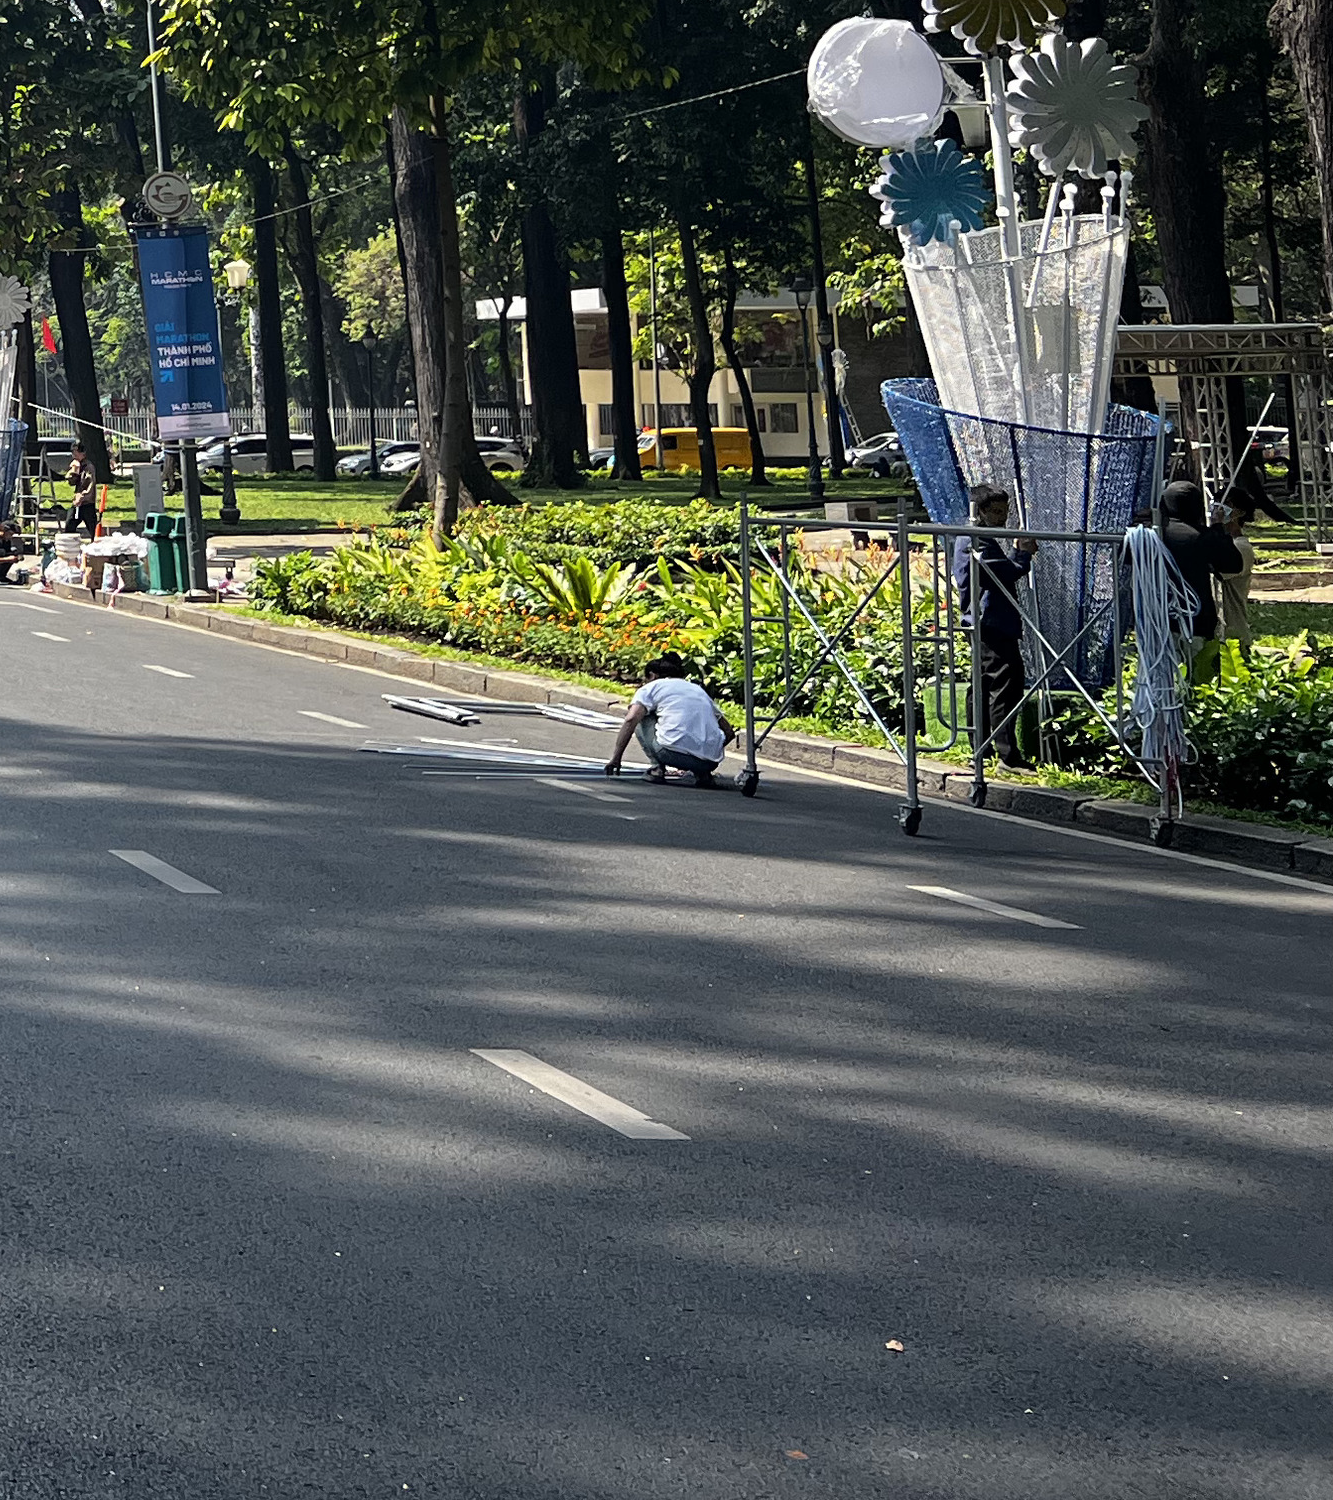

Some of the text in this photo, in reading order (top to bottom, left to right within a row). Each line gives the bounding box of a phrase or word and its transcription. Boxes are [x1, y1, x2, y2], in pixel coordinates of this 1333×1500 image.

[151, 276, 203, 285] MARATHON
[156, 333, 210, 344] MARATHON
[157, 341, 212, 356] THÀNH PHỐ
[191, 356, 215, 366] MINH
[171, 401, 213, 411] 14.01.2024
